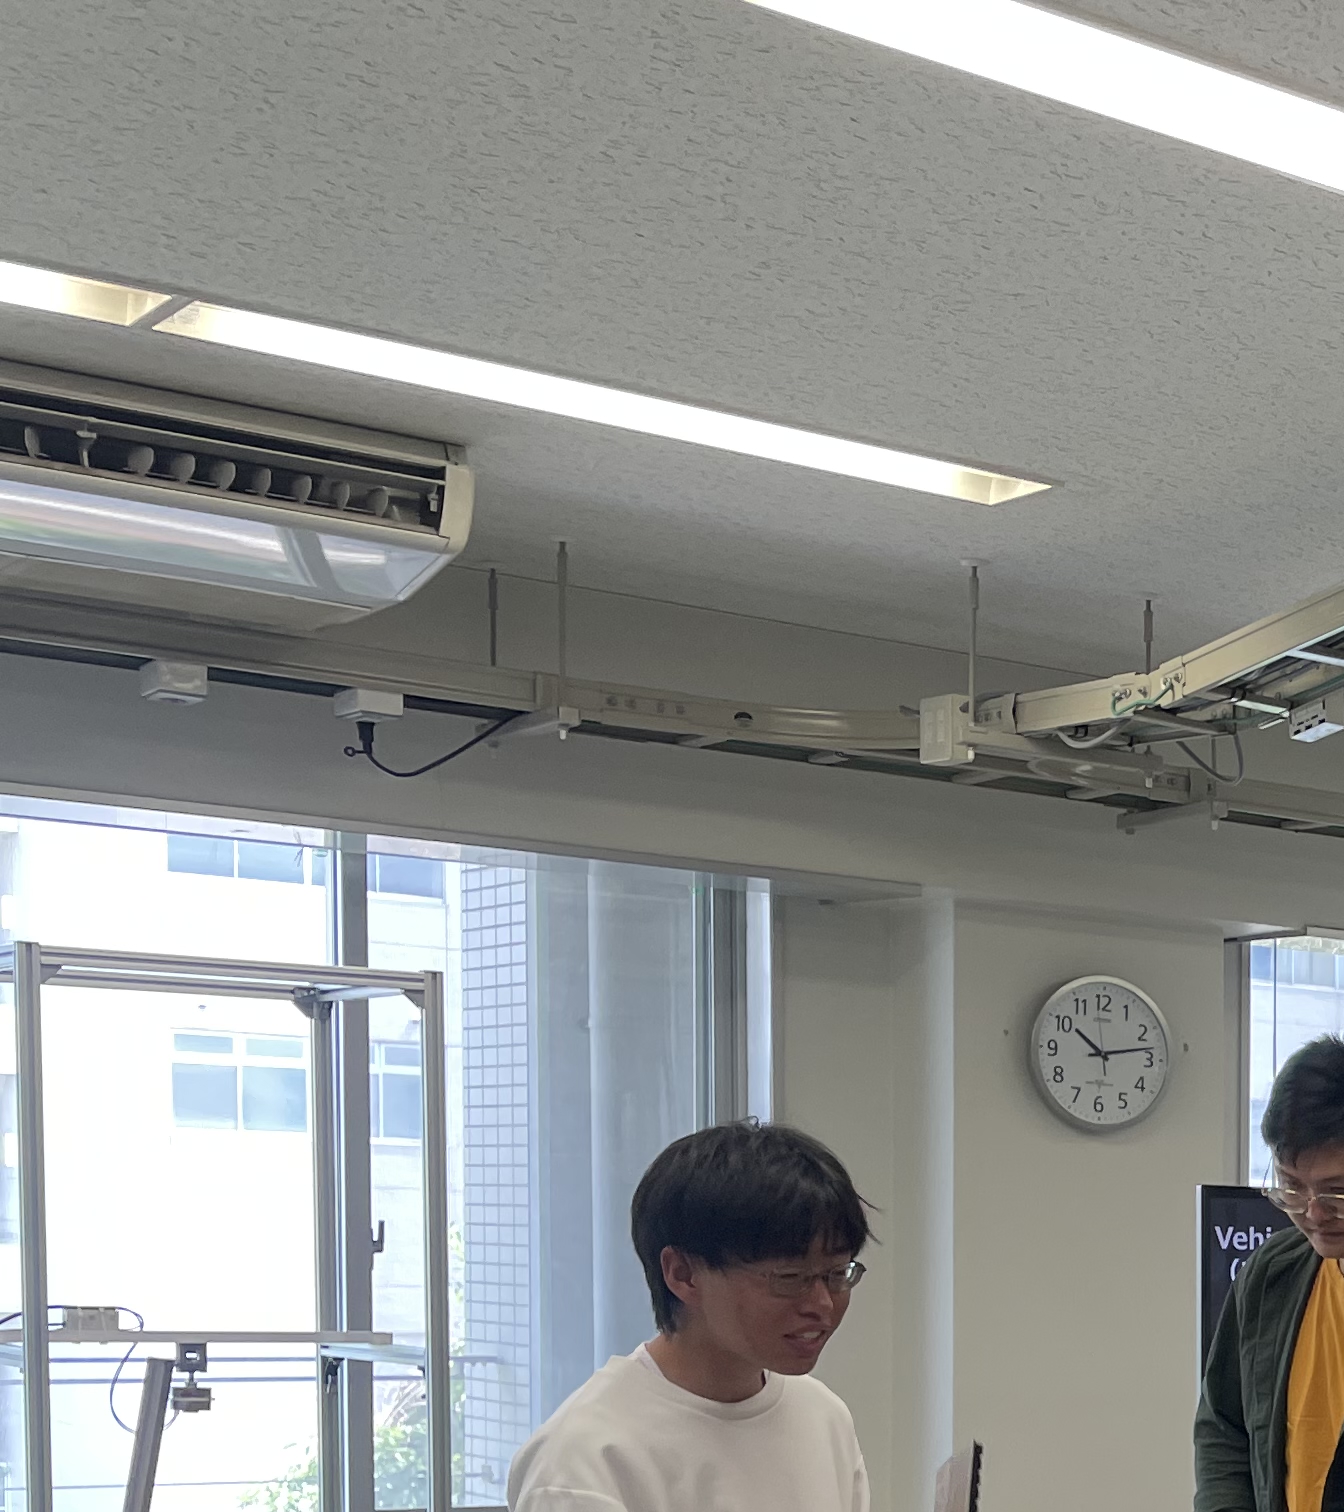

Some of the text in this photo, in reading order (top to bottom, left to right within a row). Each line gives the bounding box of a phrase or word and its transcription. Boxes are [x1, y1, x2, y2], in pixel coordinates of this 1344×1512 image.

[1073, 997, 1087, 1015] 11
[1095, 993, 1112, 1012] 12
[1122, 1004, 1129, 1022] 1
[1055, 1014, 1072, 1033] 10
[1137, 1023, 1148, 1042] 2
[1047, 1039, 1058, 1057] 9
[1143, 1051, 1154, 1068] 3
[1053, 1065, 1064, 1083] 8
[1134, 1075, 1146, 1093] 4
[1070, 1085, 1081, 1103] 7
[1117, 1092, 1128, 1109] 5
[1093, 1095, 1104, 1113] 6
